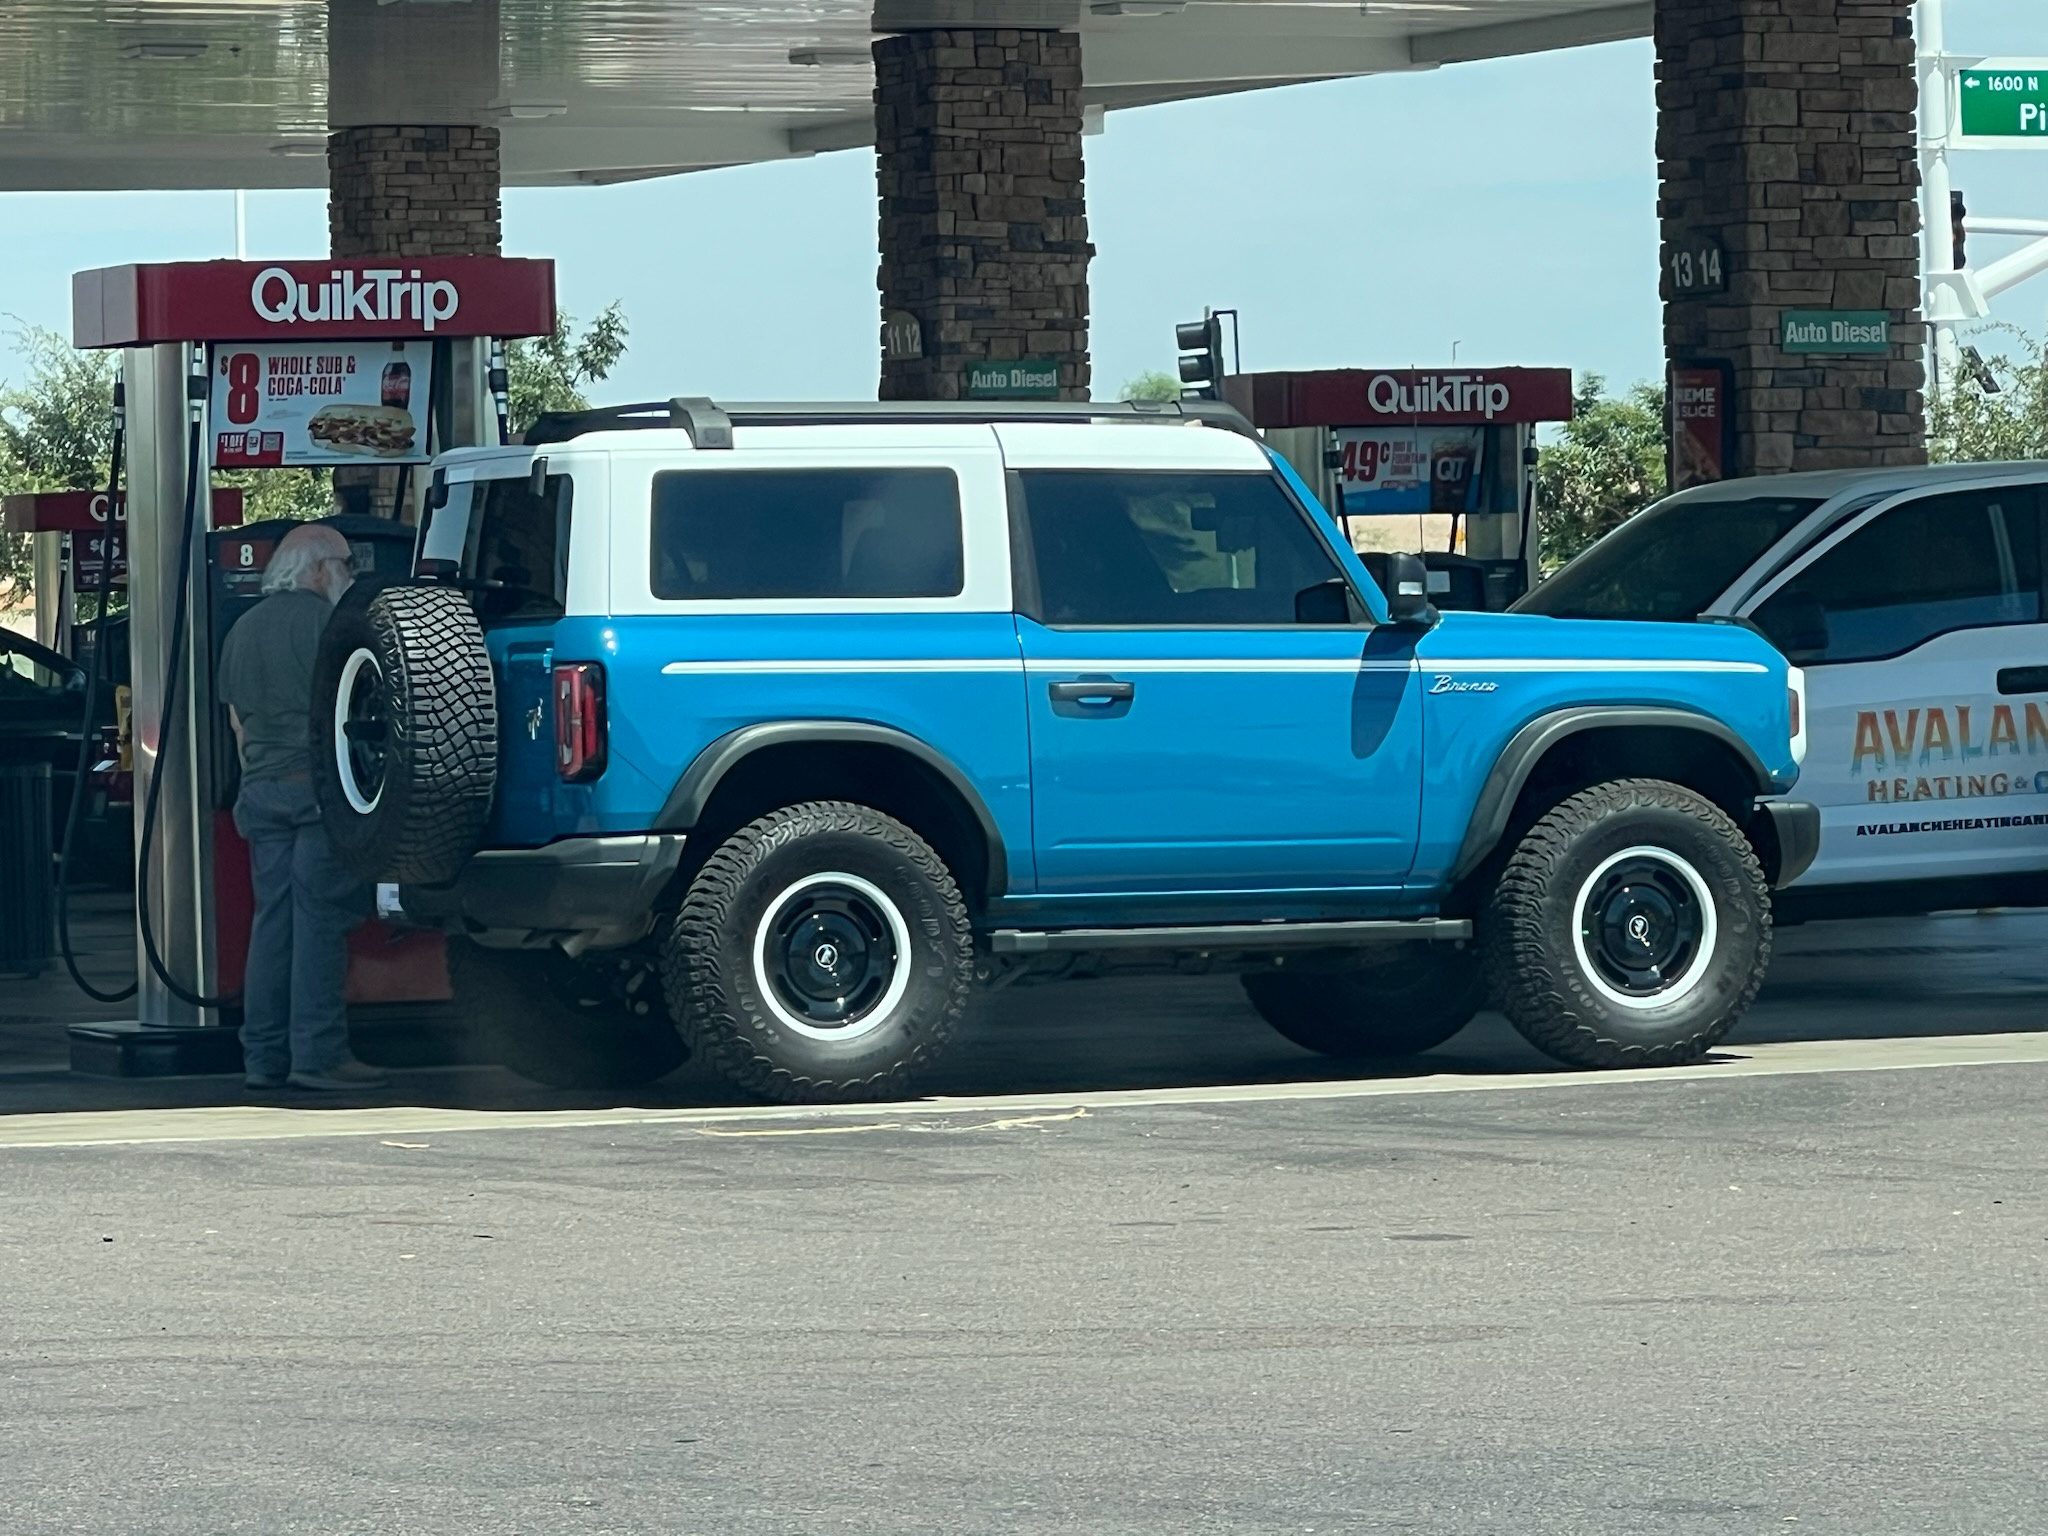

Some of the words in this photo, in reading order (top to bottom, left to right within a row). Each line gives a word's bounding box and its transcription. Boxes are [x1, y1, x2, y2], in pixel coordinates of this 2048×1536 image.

[1988, 76, 2023, 91] 1600
[2028, 76, 2038, 91] N
[1671, 252, 1693, 288] 13
[1699, 249, 1721, 285] 14
[251, 267, 459, 331] QuikTrip
[887, 325, 901, 355] 11
[905, 323, 921, 353] 12
[1785, 321, 1827, 343] Auto
[1831, 320, 1887, 343] Diesel
[268, 357, 312, 375] WHOLE
[316, 356, 342, 374] SUB
[346, 355, 356, 374] &
[971, 370, 1007, 388] Auto
[1011, 369, 1057, 388] Diesel
[1367, 374, 1510, 420] QuikTrip
[1682, 405, 1715, 417] SLICE
[1436, 457, 1467, 481] QT
[240, 544, 254, 566] 8
[1428, 674, 1499, 694] Bronco
[1868, 772, 2008, 802] HEATING
[1857, 814, 2048, 836] AVALANCHEHEATINGAN
